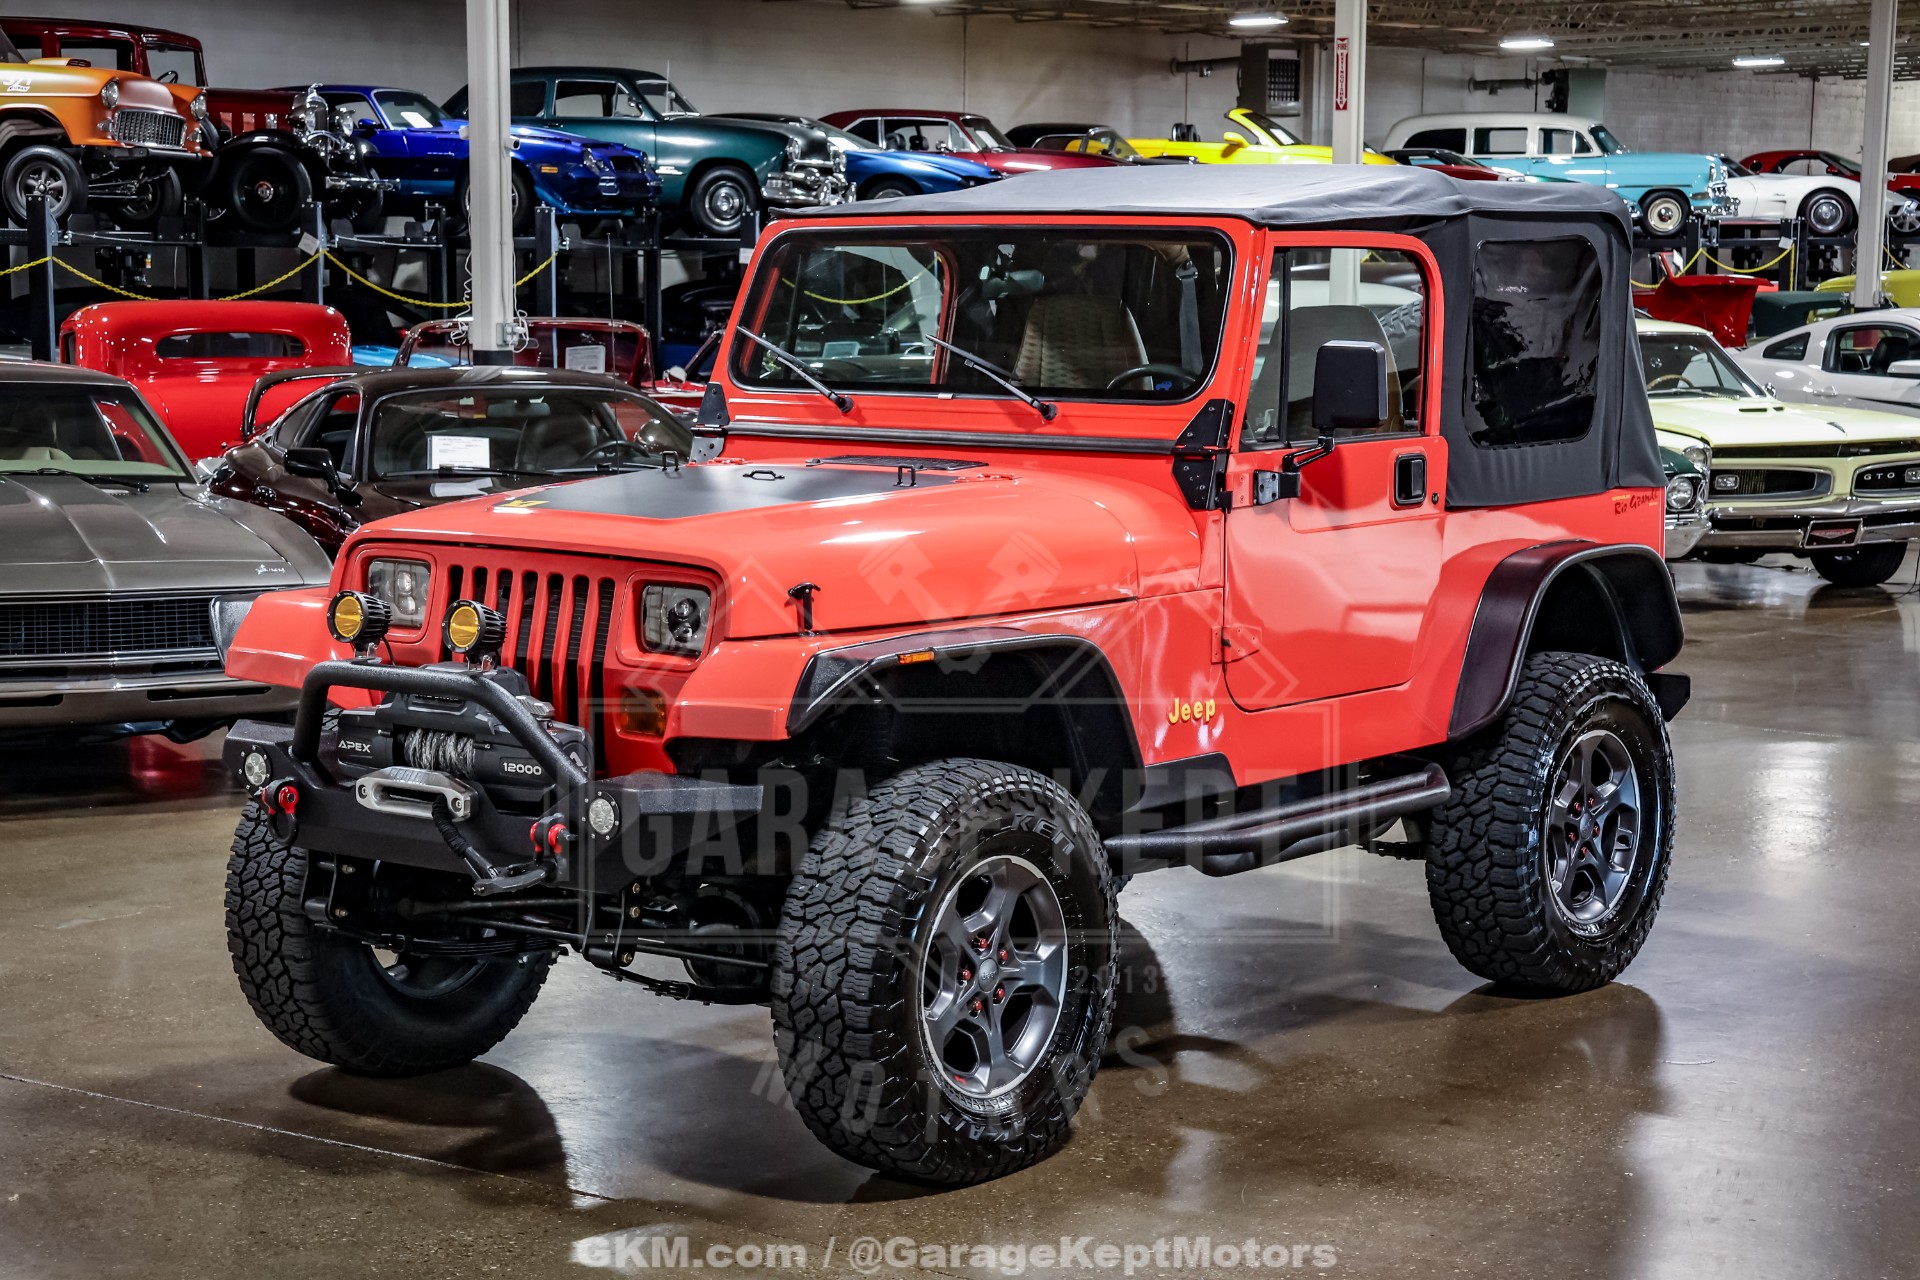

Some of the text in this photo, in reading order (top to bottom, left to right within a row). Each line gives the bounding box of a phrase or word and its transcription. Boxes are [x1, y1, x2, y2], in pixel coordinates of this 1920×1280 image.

[1614, 488, 1658, 516] Rio Grande
[1168, 697, 1216, 725] Jeep
[338, 740, 371, 753] APEX
[502, 762, 542, 776] 12000
